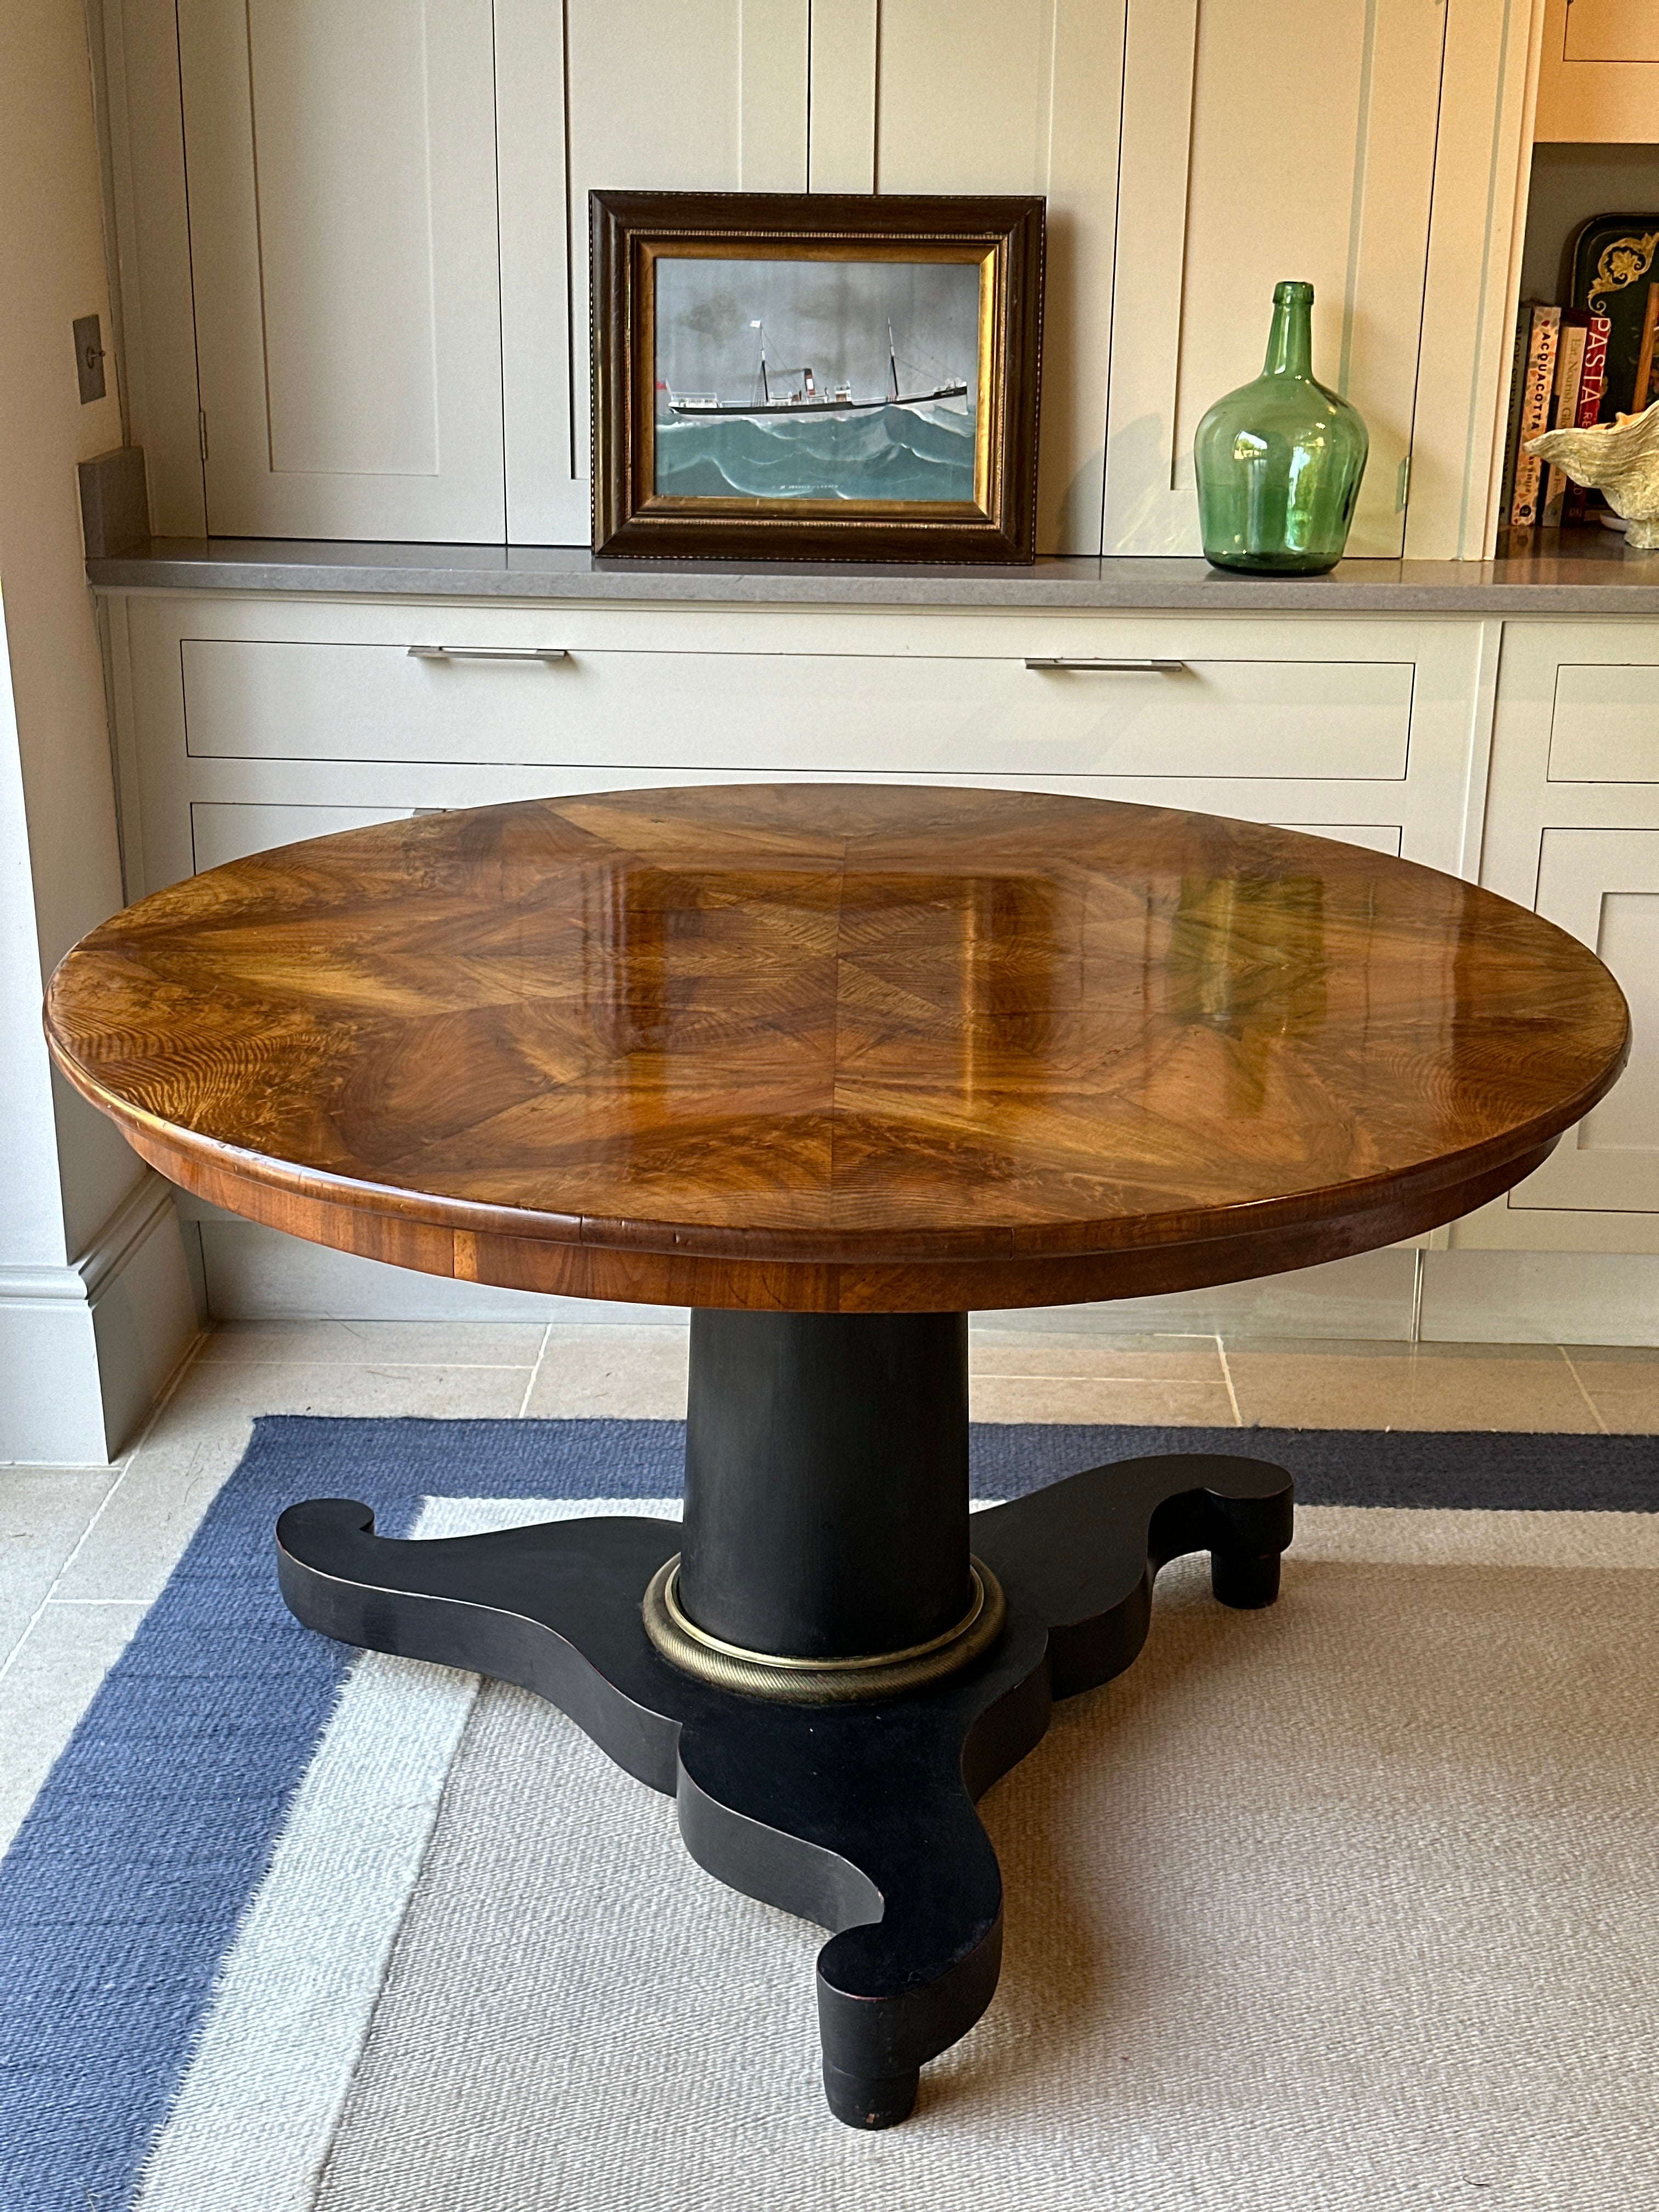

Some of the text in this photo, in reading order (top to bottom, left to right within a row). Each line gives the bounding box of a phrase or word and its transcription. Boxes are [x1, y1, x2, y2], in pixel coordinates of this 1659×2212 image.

[1531, 332, 1551, 430] ACQUACOTTA
[1580, 317, 1611, 404] PASTA
[1561, 408, 1572, 429] Glo
